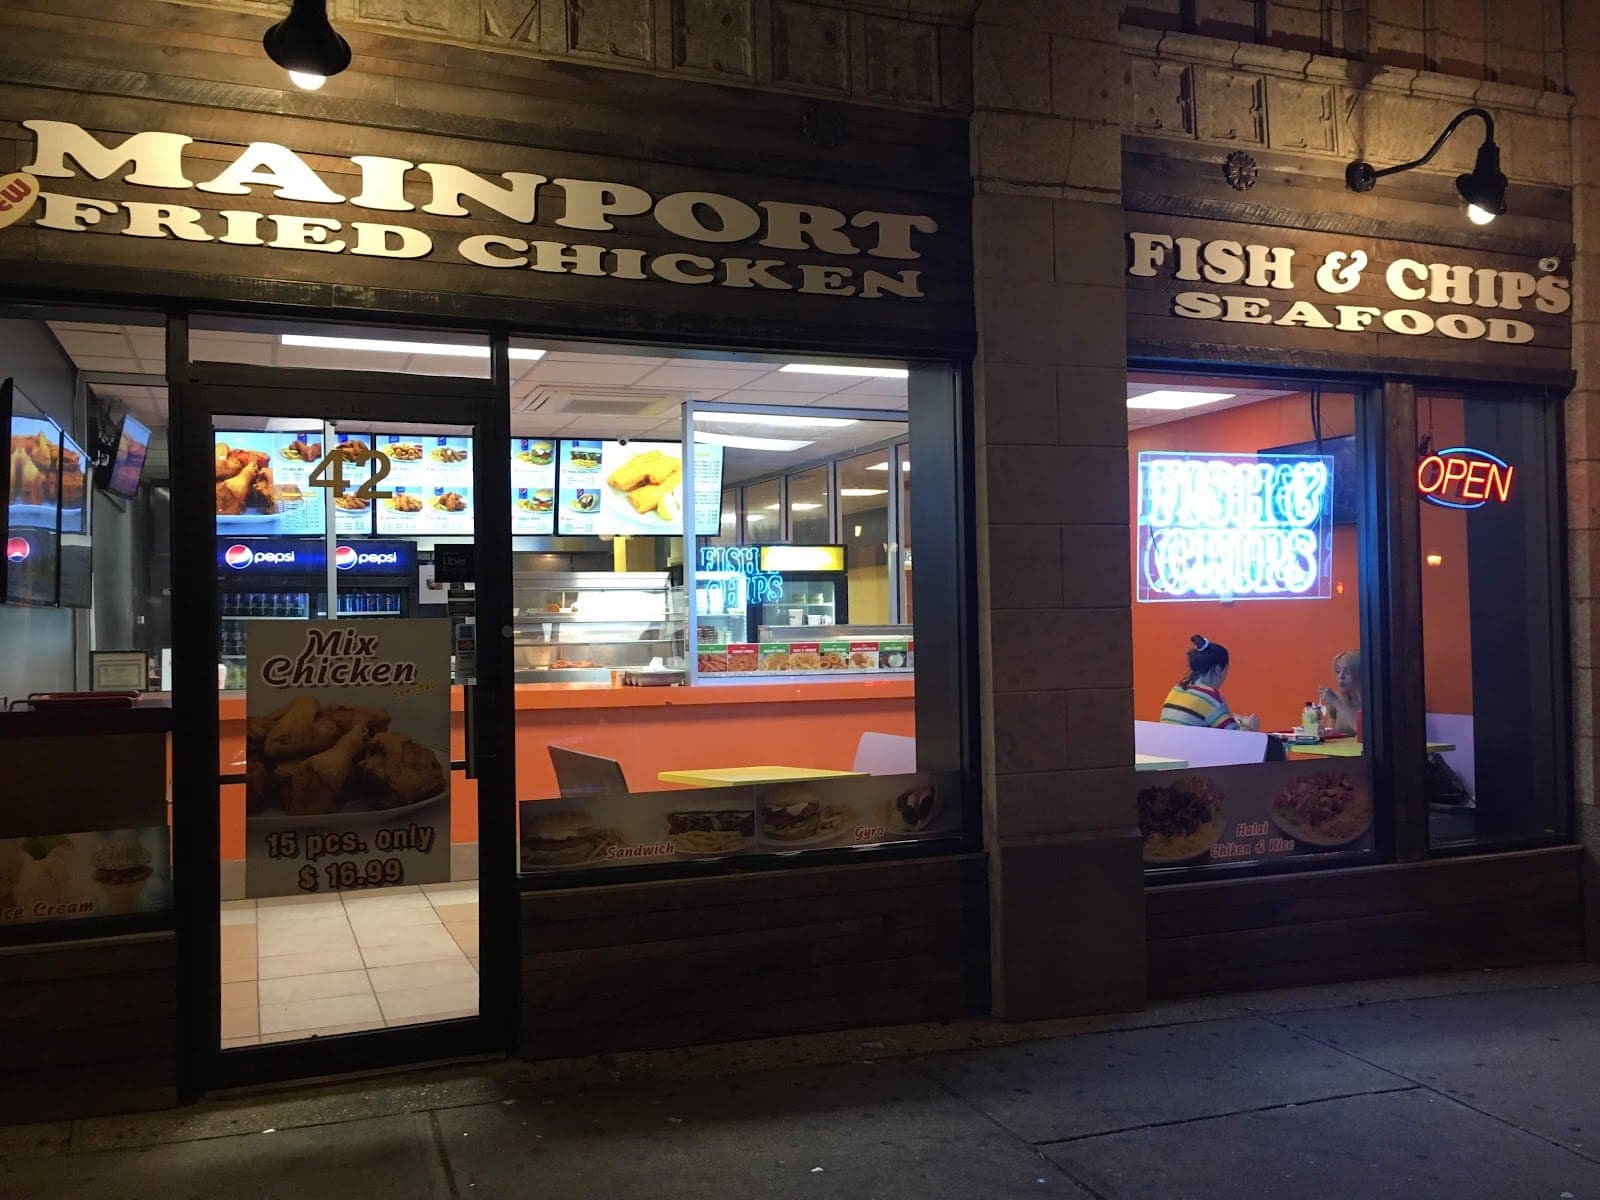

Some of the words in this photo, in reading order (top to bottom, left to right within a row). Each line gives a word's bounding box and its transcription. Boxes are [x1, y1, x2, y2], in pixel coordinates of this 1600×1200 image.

[22, 120, 937, 259] MAINPORT
[36, 191, 432, 258] FRIED
[458, 235, 924, 298] CHICKEN
[1129, 232, 1295, 290] FISH
[1316, 249, 1368, 295] &
[1386, 258, 1571, 315] CHIPS
[1174, 292, 1535, 344] SEAFOOD
[308, 449, 393, 499] 42
[1418, 455, 1514, 502] OPEN
[253, 550, 295, 566] pepsi
[358, 551, 397, 566] pepsi
[305, 628, 379, 657] Mix
[262, 655, 418, 688] Chicken
[266, 832, 300, 858] 15
[305, 829, 367, 862] pcs.
[374, 823, 435, 852] only
[854, 825, 885, 841] Gyro
[1235, 821, 1270, 838] Halal
[1268, 837, 1296, 854] Rice
[607, 841, 675, 860] Sandwich
[298, 864, 321, 892] $
[325, 858, 404, 889] 16.99
[33, 900, 94, 918] Cream
